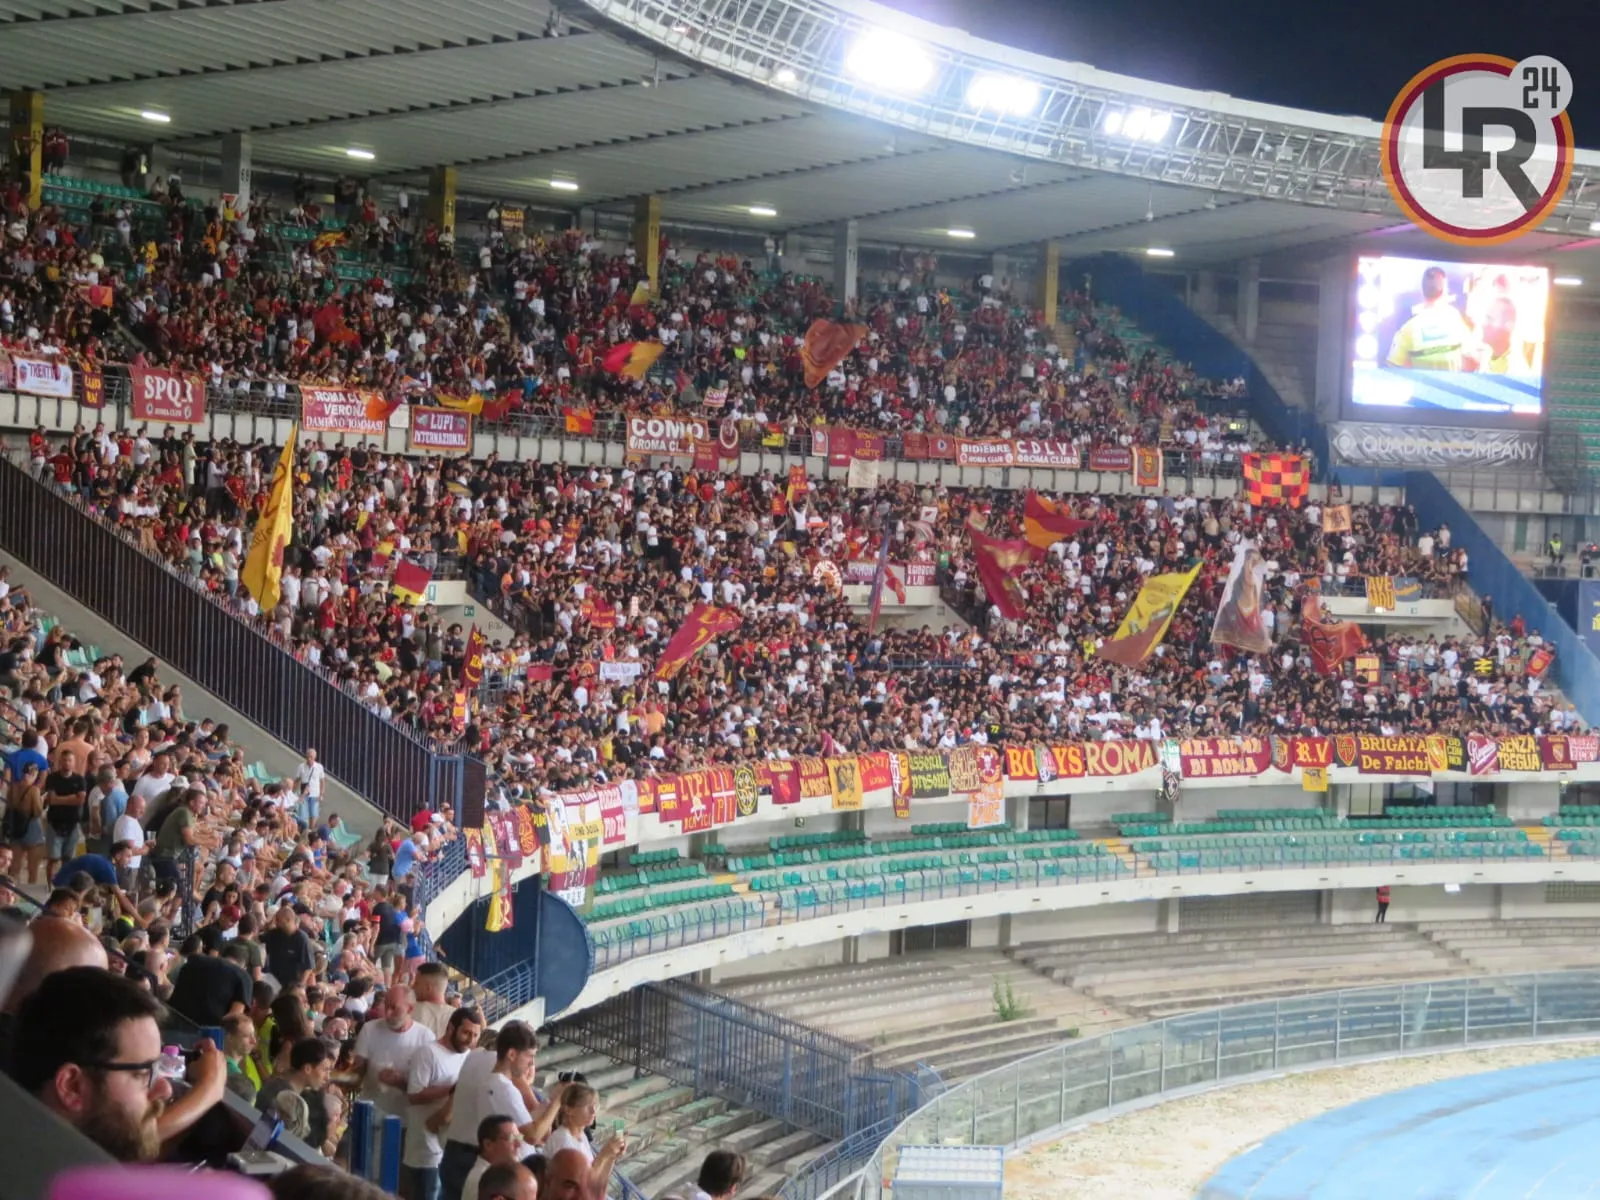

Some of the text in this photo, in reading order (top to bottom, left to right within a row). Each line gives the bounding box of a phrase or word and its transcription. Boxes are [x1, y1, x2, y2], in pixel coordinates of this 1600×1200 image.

[314, 391, 346, 402] ROMA
[323, 403, 367, 417] VERONA
[306, 416, 344, 429] DAMIANO
[431, 413, 453, 431] LUPI
[631, 418, 704, 439] COMO
[638, 438, 668, 451] ROMA
[669, 440, 695, 453] CLB
[1362, 435, 1538, 461] QUADRA COMPANY
[1023, 455, 1072, 465] ROMA CLUB
[1359, 736, 1427, 752] BRIGATA
[1499, 735, 1536, 753] SENZA
[1084, 740, 1156, 775] ROMA
[1211, 757, 1258, 775] ROMA
[1361, 754, 1430, 771] De Falchi
[1497, 752, 1541, 770] TREGUA
